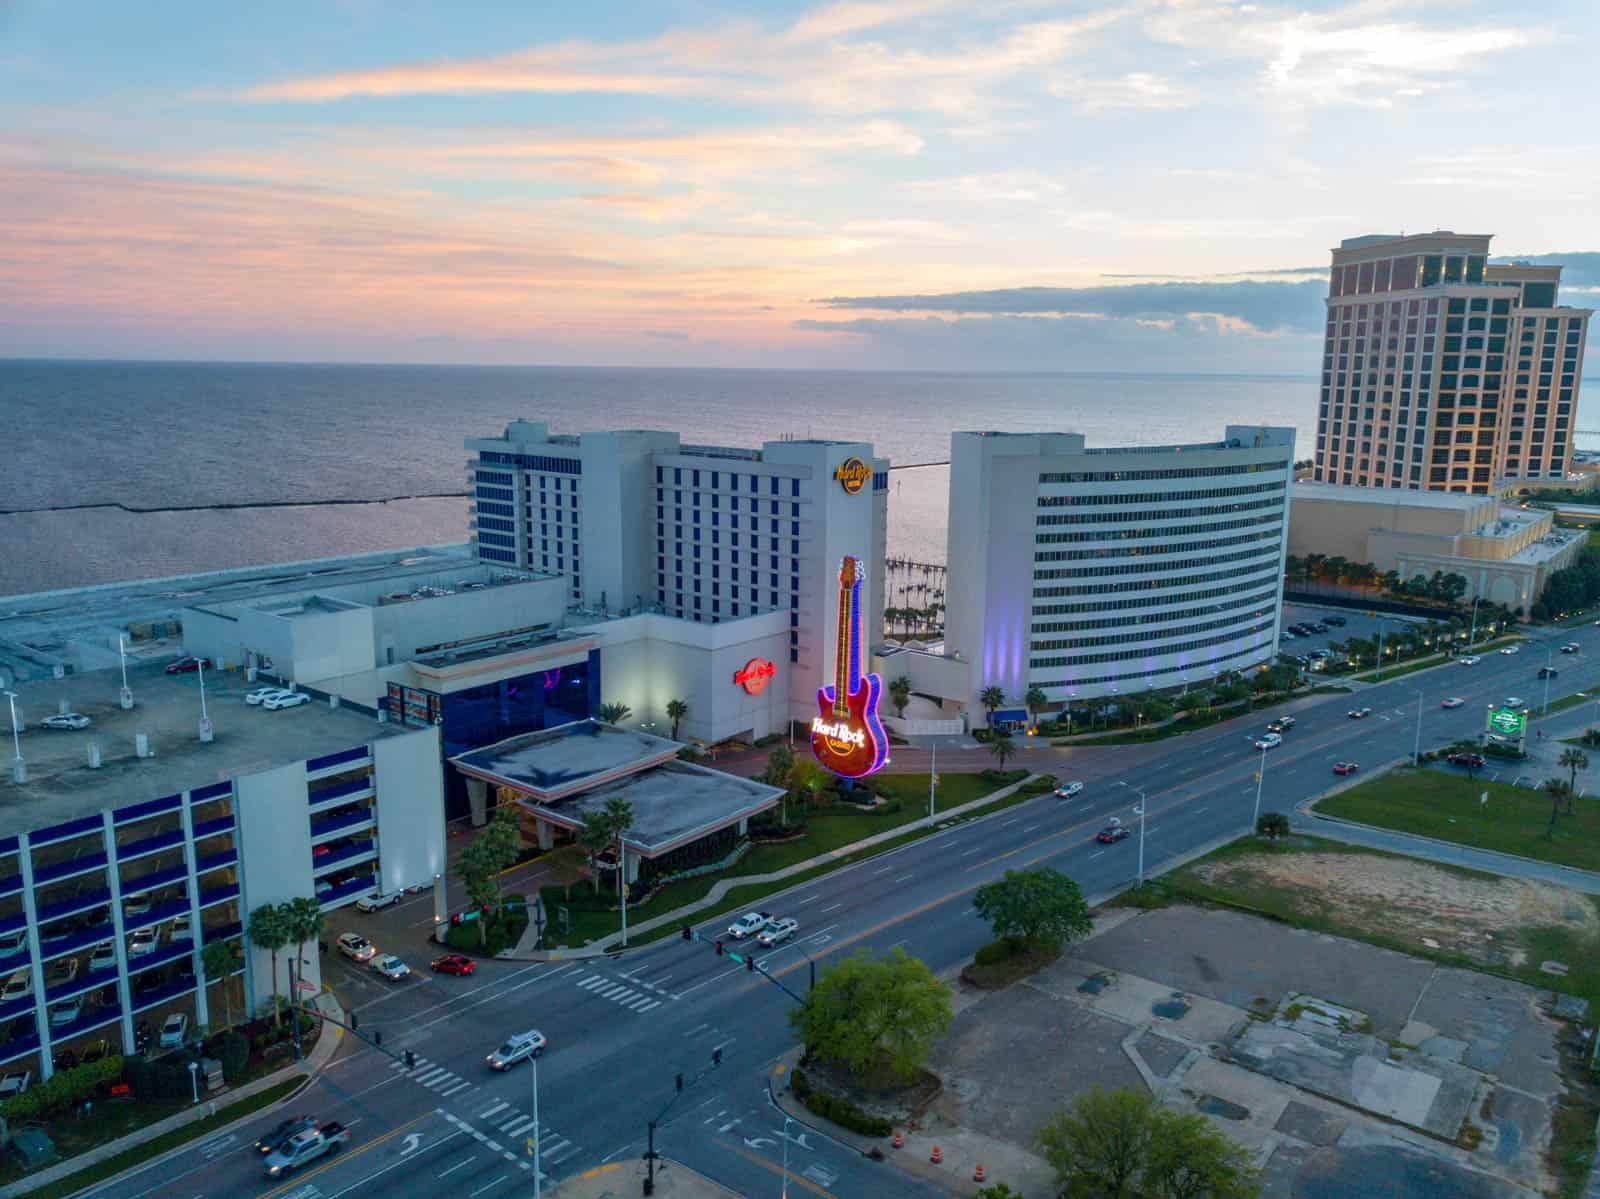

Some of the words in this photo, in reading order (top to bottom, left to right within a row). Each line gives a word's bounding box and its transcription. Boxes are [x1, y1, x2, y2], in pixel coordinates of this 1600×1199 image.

[836, 464, 855, 480] Hard
[855, 464, 873, 481] Rock
[812, 718, 839, 737] Hard
[838, 724, 865, 748] Rock
